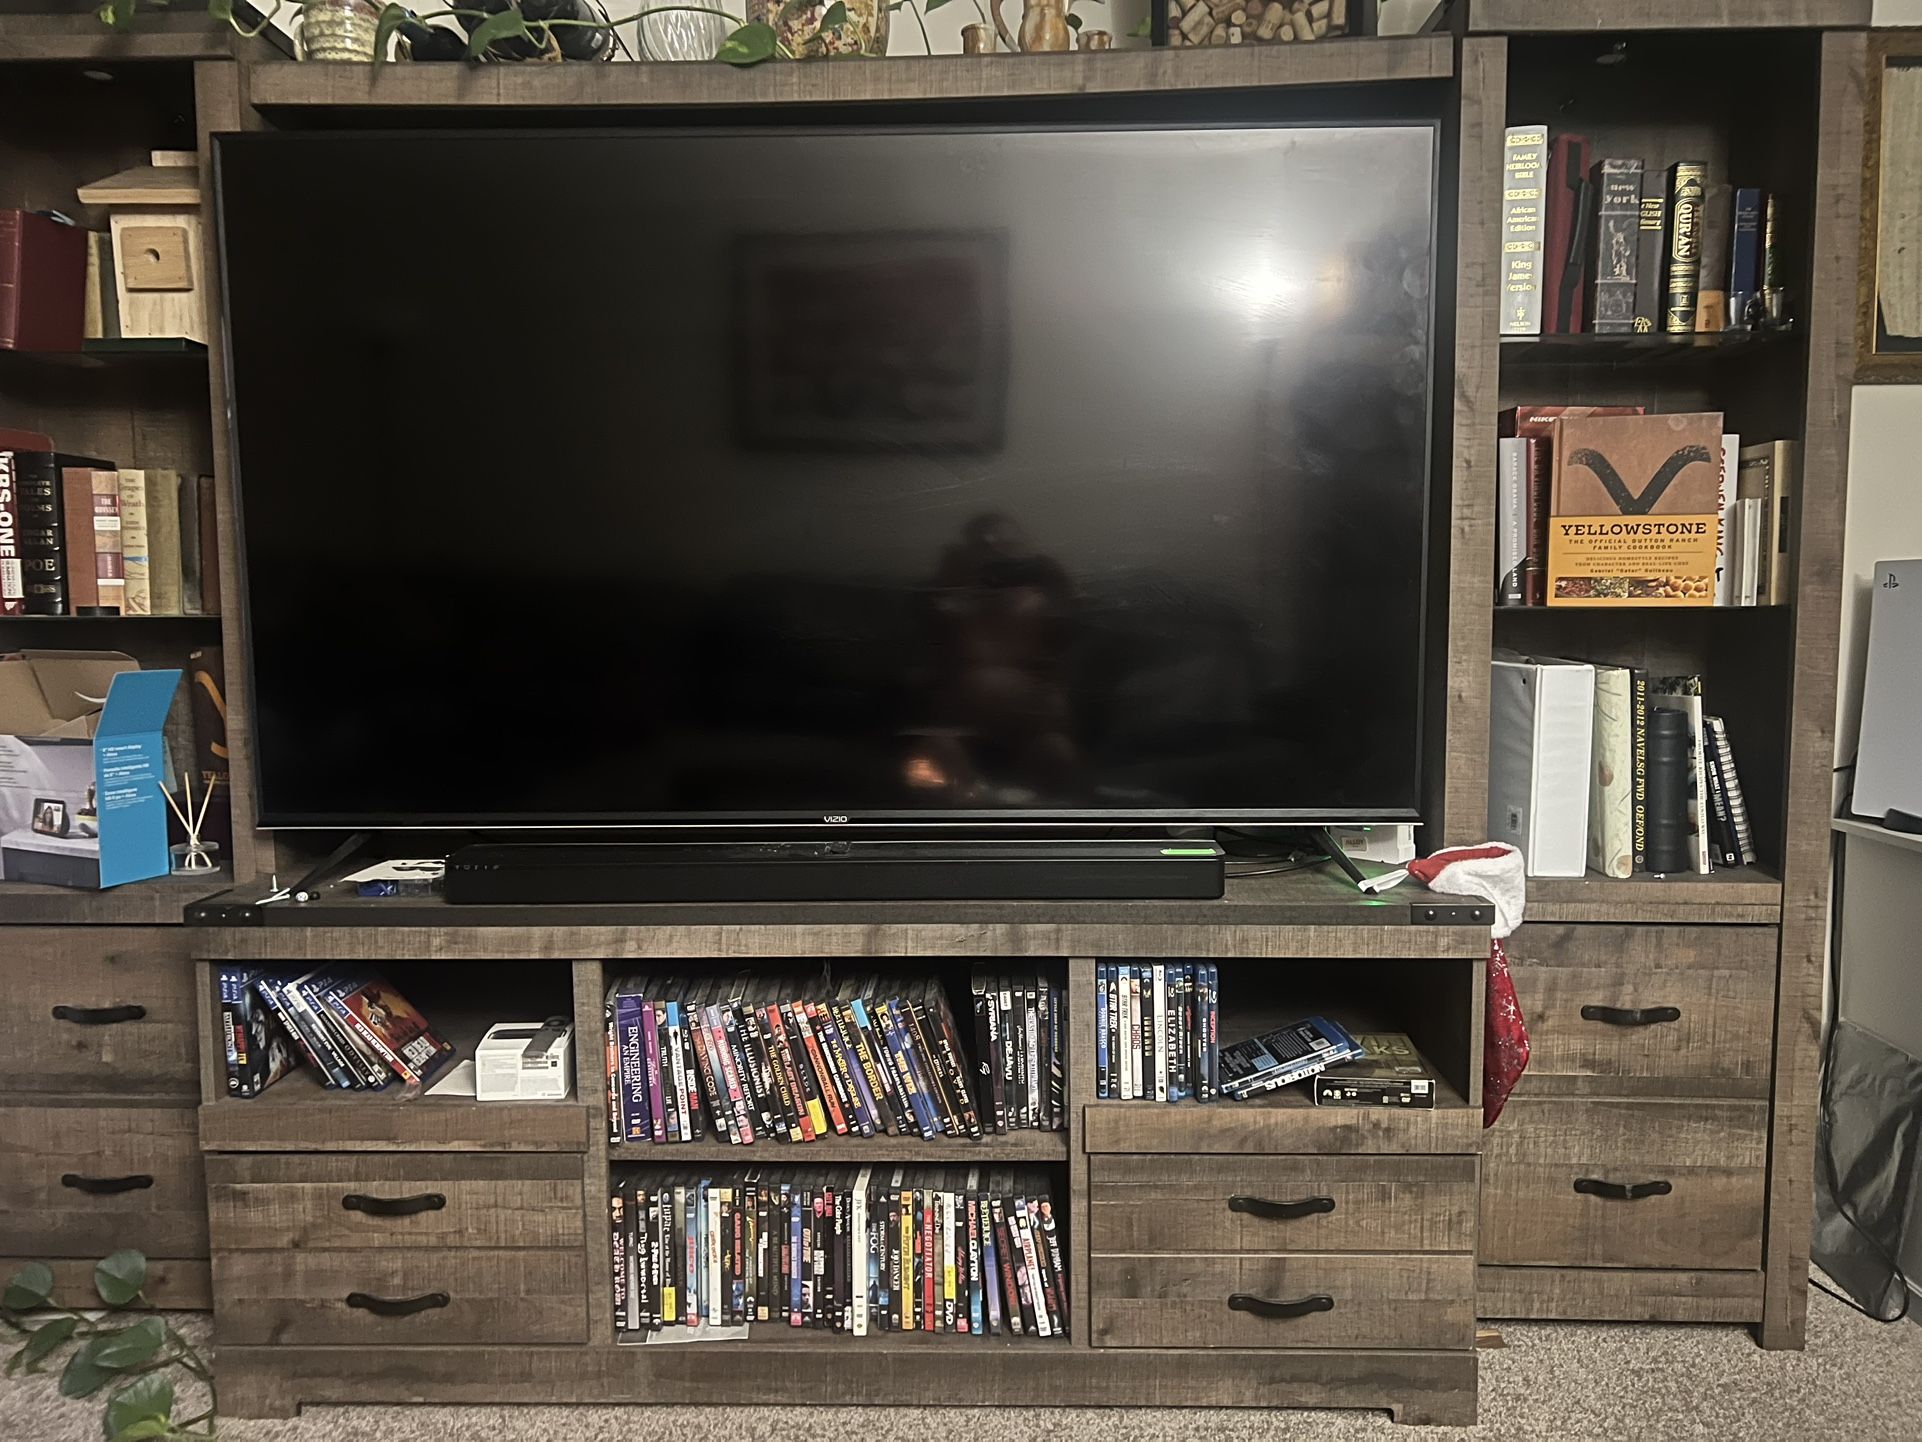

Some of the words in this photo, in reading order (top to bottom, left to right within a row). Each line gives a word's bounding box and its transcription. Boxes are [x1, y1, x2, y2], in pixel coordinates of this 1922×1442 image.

[1512, 153, 1538, 162] FAMILY
[1511, 206, 1536, 214] African
[1510, 223, 1535, 232] Edition
[1508, 272, 1533, 281] Jame
[1511, 260, 1532, 271] King
[1561, 523, 1706, 536] YELLOWSTONE
[1636, 680, 1646, 725] 2011-2012
[1636, 727, 1645, 777] NAVELSG
[1636, 779, 1645, 801] FWD
[1635, 805, 1645, 851] OEF/OND
[261, 990, 274, 1006] PS4
[305, 996, 318, 1011] PS4
[332, 1001, 347, 1016] PS4
[1109, 993, 1117, 1012] STAR
[832, 1006, 853, 1050] BEETLEJUICE
[908, 1023, 921, 1041] 1408
[987, 1000, 998, 1042] SYRIANA
[1109, 1012, 1117, 1029] TREK
[1156, 1014, 1164, 1053] LINCOLN
[622, 1045, 629, 1055] AN
[1132, 1024, 1140, 1050] CHAOS
[1167, 1010, 1176, 1073] ELIZABETH
[623, 1057, 631, 1085] EMPIRE
[628, 1026, 642, 1102] ENGINEERING
[660, 1046, 668, 1067] TRUTH
[674, 1047, 684, 1087] VANTAGE
[744, 1044, 765, 1098] ILLUSIONIST
[731, 1045, 746, 1082] MINORITY
[743, 1084, 755, 1111] REPORT
[768, 1045, 776, 1059] THE
[772, 1060, 783, 1086] GOLDEN
[780, 1086, 790, 1106] CHILD
[799, 1063, 811, 1093] BLADE
[855, 1042, 867, 1061] THE
[866, 1062, 884, 1101] BORDER
[883, 1046, 892, 1066] YOUNG
[890, 1066, 909, 1108] FRANKENSTEIN
[894, 1051, 908, 1073] THE
[902, 1072, 917, 1095] WIZ
[1005, 1066, 1013, 1081] VU
[706, 1076, 717, 1097] CODE
[690, 1093, 699, 1110] MAN
[968, 1200, 976, 1240] MICHAEL
[980, 1200, 991, 1247] BEETLEJUICE
[870, 1232, 878, 1253] FOG
[925, 1224, 933, 1278] NEGOTIATOR
[997, 1227, 1008, 1261] SECRET
[1022, 1238, 1035, 1271] AIRPLANE!
[1047, 1235, 1056, 1247] JEFF
[969, 1240, 978, 1281] CLAYTON
[1002, 1263, 1017, 1306] WINDOW
[945, 1301, 954, 1325] DVD
